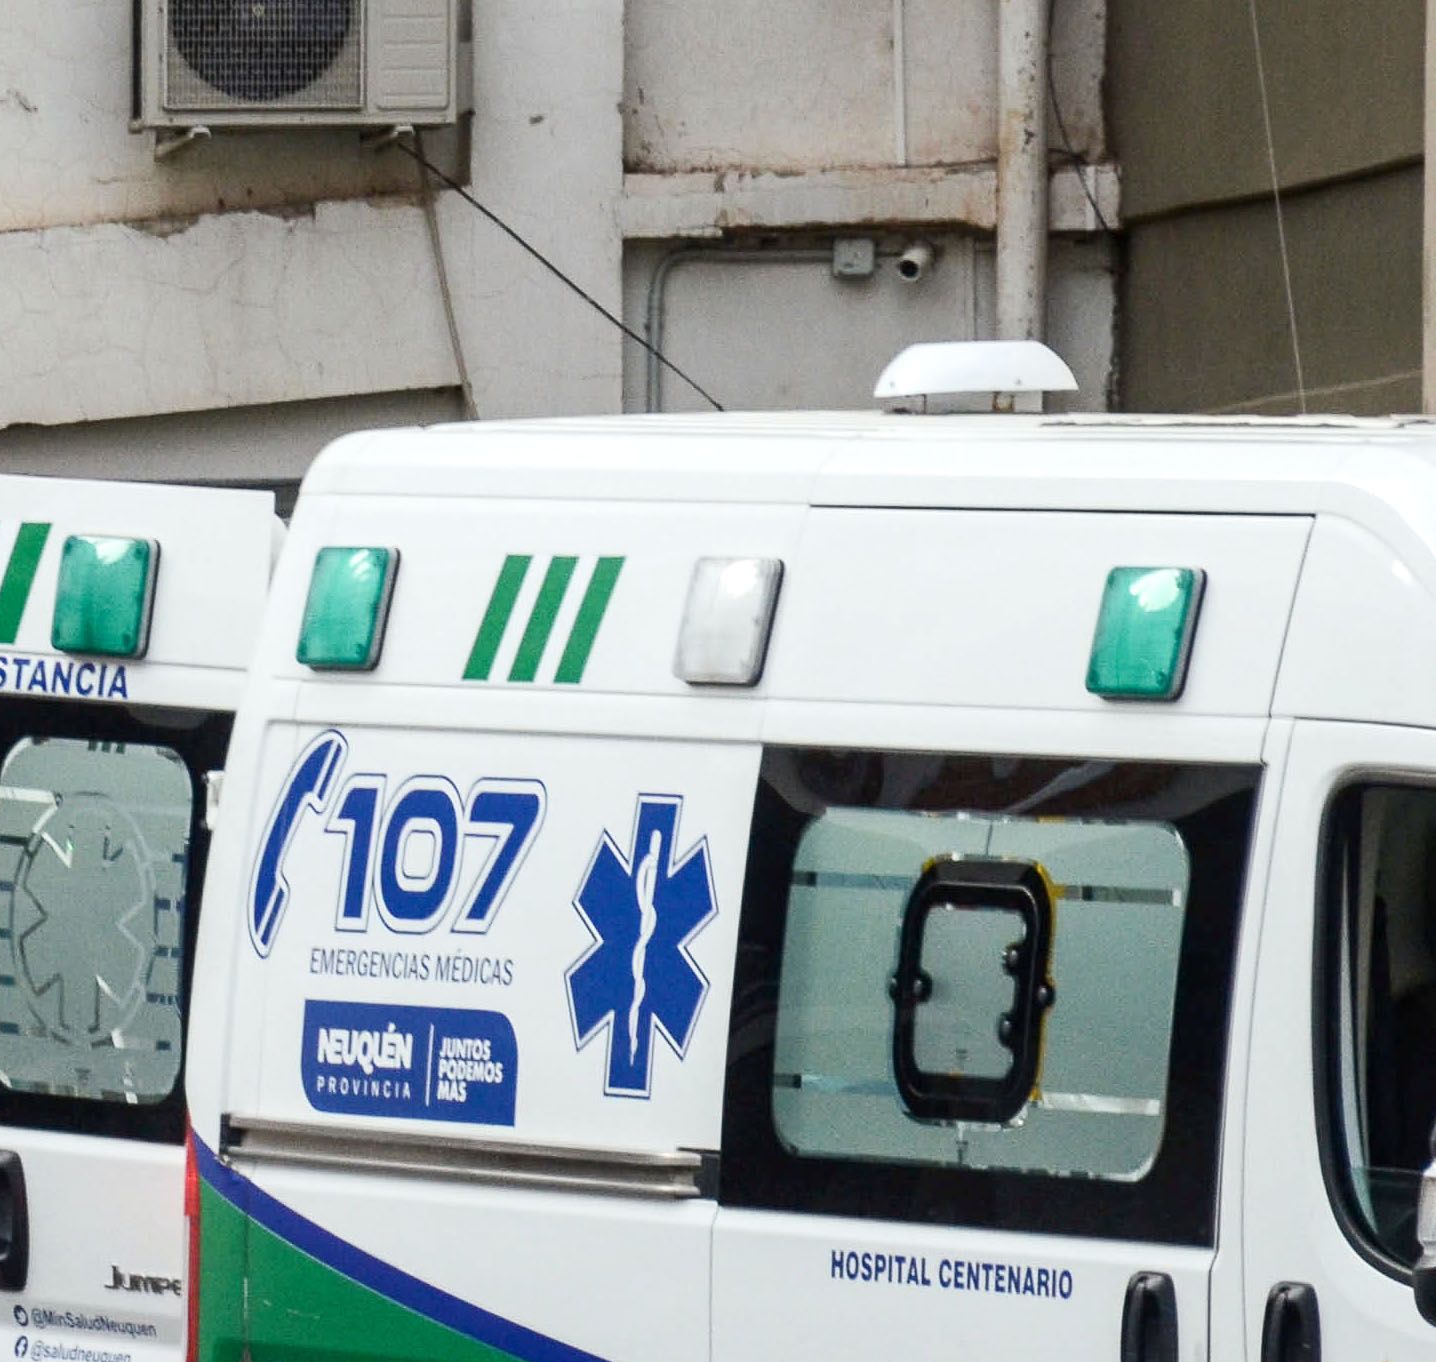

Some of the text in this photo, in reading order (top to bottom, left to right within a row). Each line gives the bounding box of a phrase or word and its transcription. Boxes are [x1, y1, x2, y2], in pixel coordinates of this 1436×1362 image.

[325, 773, 548, 935] 107
[309, 948, 514, 986] EMERGENCIAS MÉDICAS
[317, 1021, 413, 1075] NEUQUÉN
[439, 1037, 491, 1061] JUNTOS
[316, 1075, 412, 1100] PROVINCIA
[438, 1058, 504, 1084] PODEMOS
[830, 1249, 1074, 1300] HOSPITAL CENTENARIO
[30, 1307, 158, 1338] @MinSaludNeuquen
